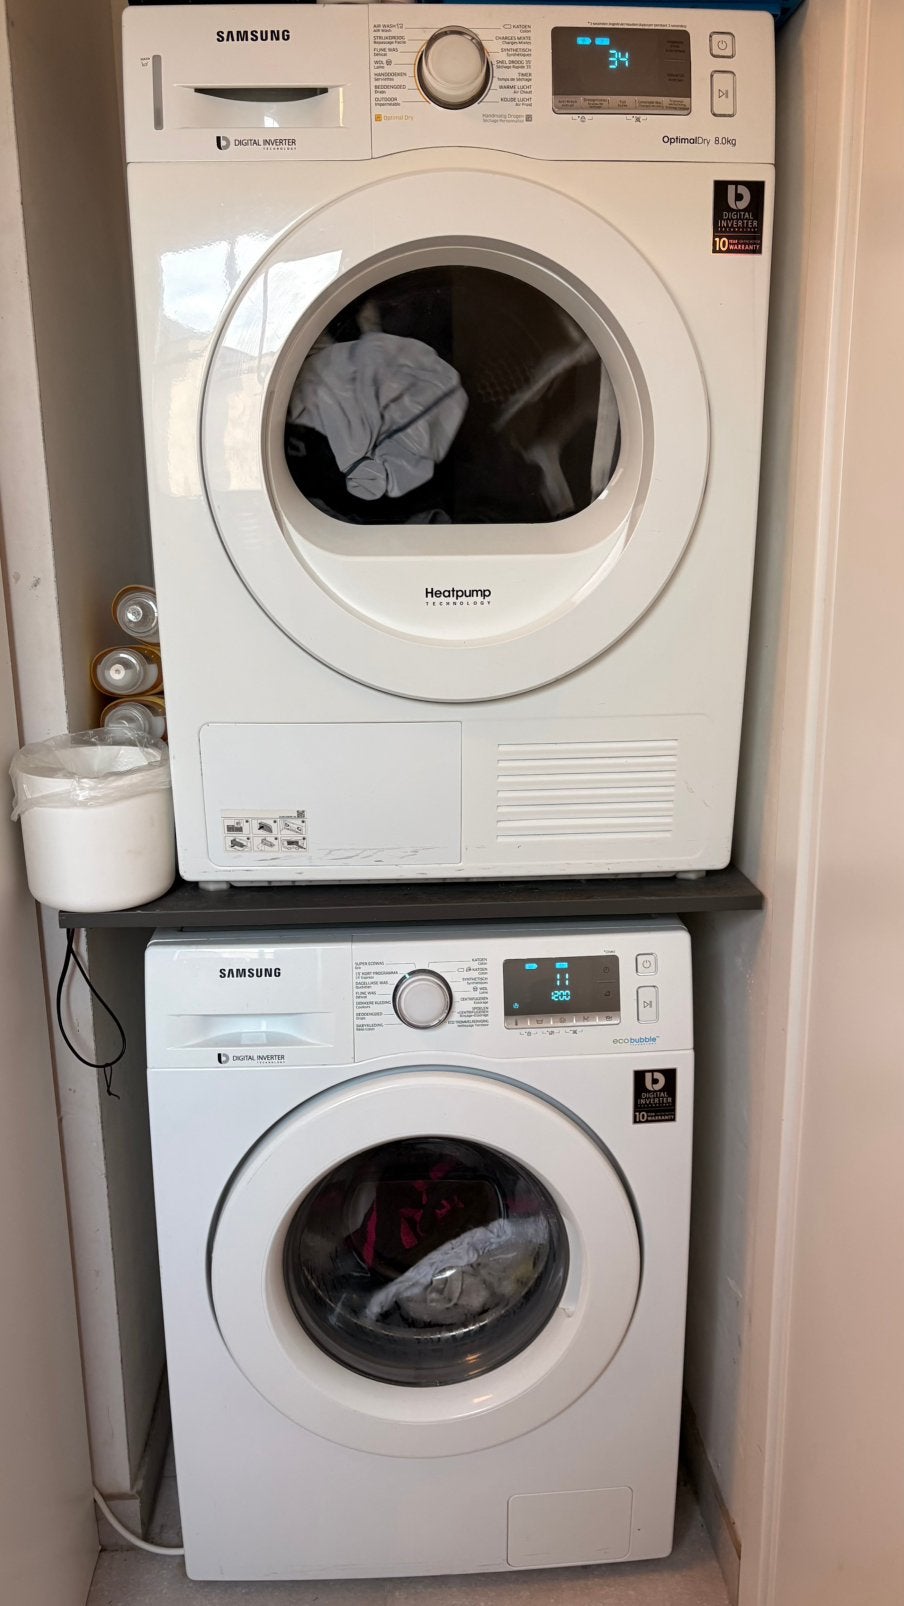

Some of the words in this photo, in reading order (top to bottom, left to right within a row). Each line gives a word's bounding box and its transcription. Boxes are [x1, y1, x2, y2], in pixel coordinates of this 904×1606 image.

[216, 30, 290, 42] SAMSUNG
[608, 49, 628, 68] 34
[234, 138, 262, 147] DIGITAL
[262, 138, 297, 147] INVERTER
[662, 136, 710, 146] OptimalDry
[714, 137, 737, 147] 8.0kg
[714, 237, 728, 251] 10
[425, 587, 491, 600] Heatpump
[220, 968, 281, 978] SAMSUNG
[556, 973, 569, 986] 11
[551, 990, 571, 1001] 1200
[613, 1036, 657, 1045] ecobubble
[635, 1112, 647, 1122] 10
